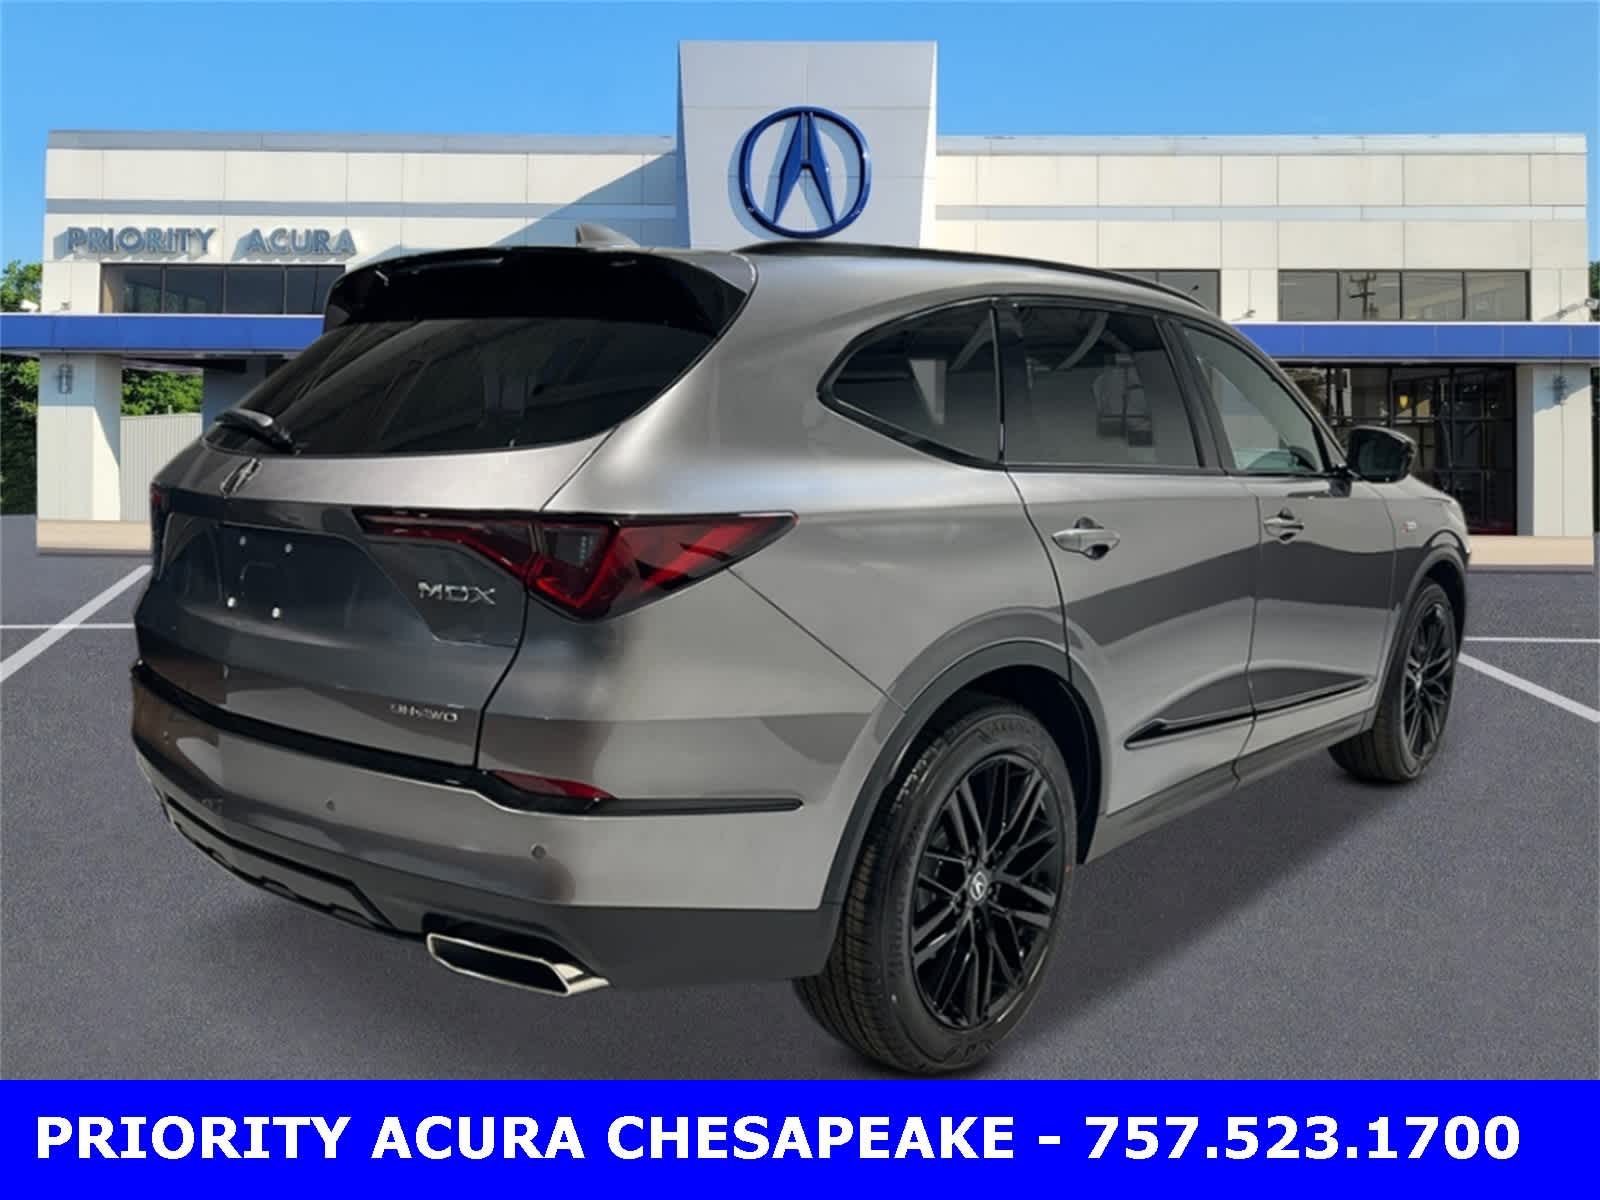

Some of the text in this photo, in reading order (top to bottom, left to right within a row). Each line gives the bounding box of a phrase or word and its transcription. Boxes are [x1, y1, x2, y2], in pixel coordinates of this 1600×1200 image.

[65, 226, 357, 255] PRIORITY ACURA
[417, 580, 497, 606] MDX
